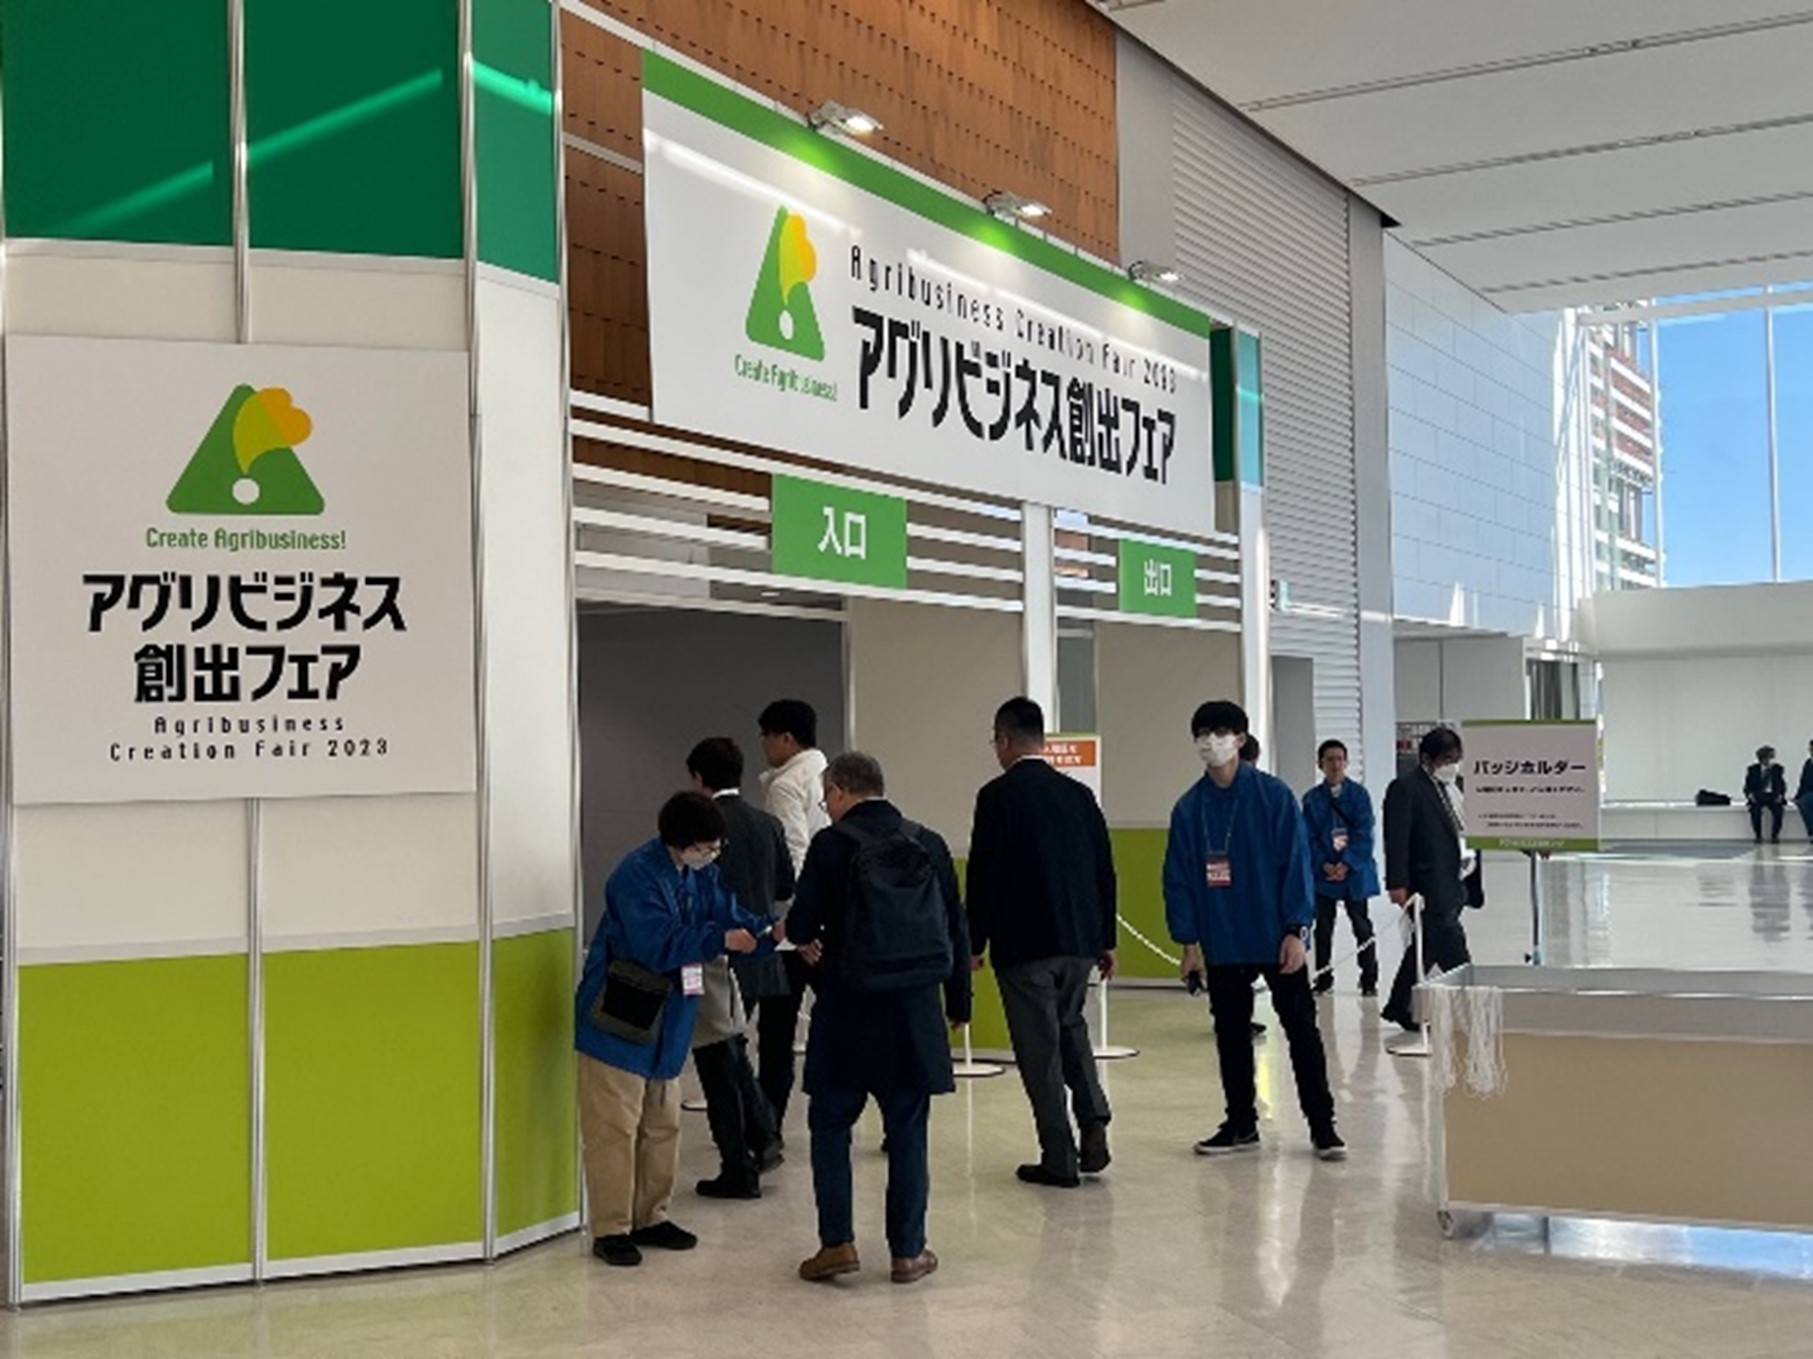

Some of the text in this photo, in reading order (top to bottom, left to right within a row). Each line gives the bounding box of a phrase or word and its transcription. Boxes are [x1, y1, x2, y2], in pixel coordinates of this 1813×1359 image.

[850, 245, 1004, 331] Agribusiness
[852, 305, 1176, 485] アグリビジネス創出フェア
[145, 527, 347, 552] Create Agribusiness!
[818, 505, 867, 560] 入口
[82, 571, 407, 633] アグリビジネス
[1143, 560, 1173, 597] 出口
[133, 643, 361, 703] 創出フェア
[109, 738, 389, 762] Creation Fair 2023
[154, 714, 344, 738] Agribusiness
